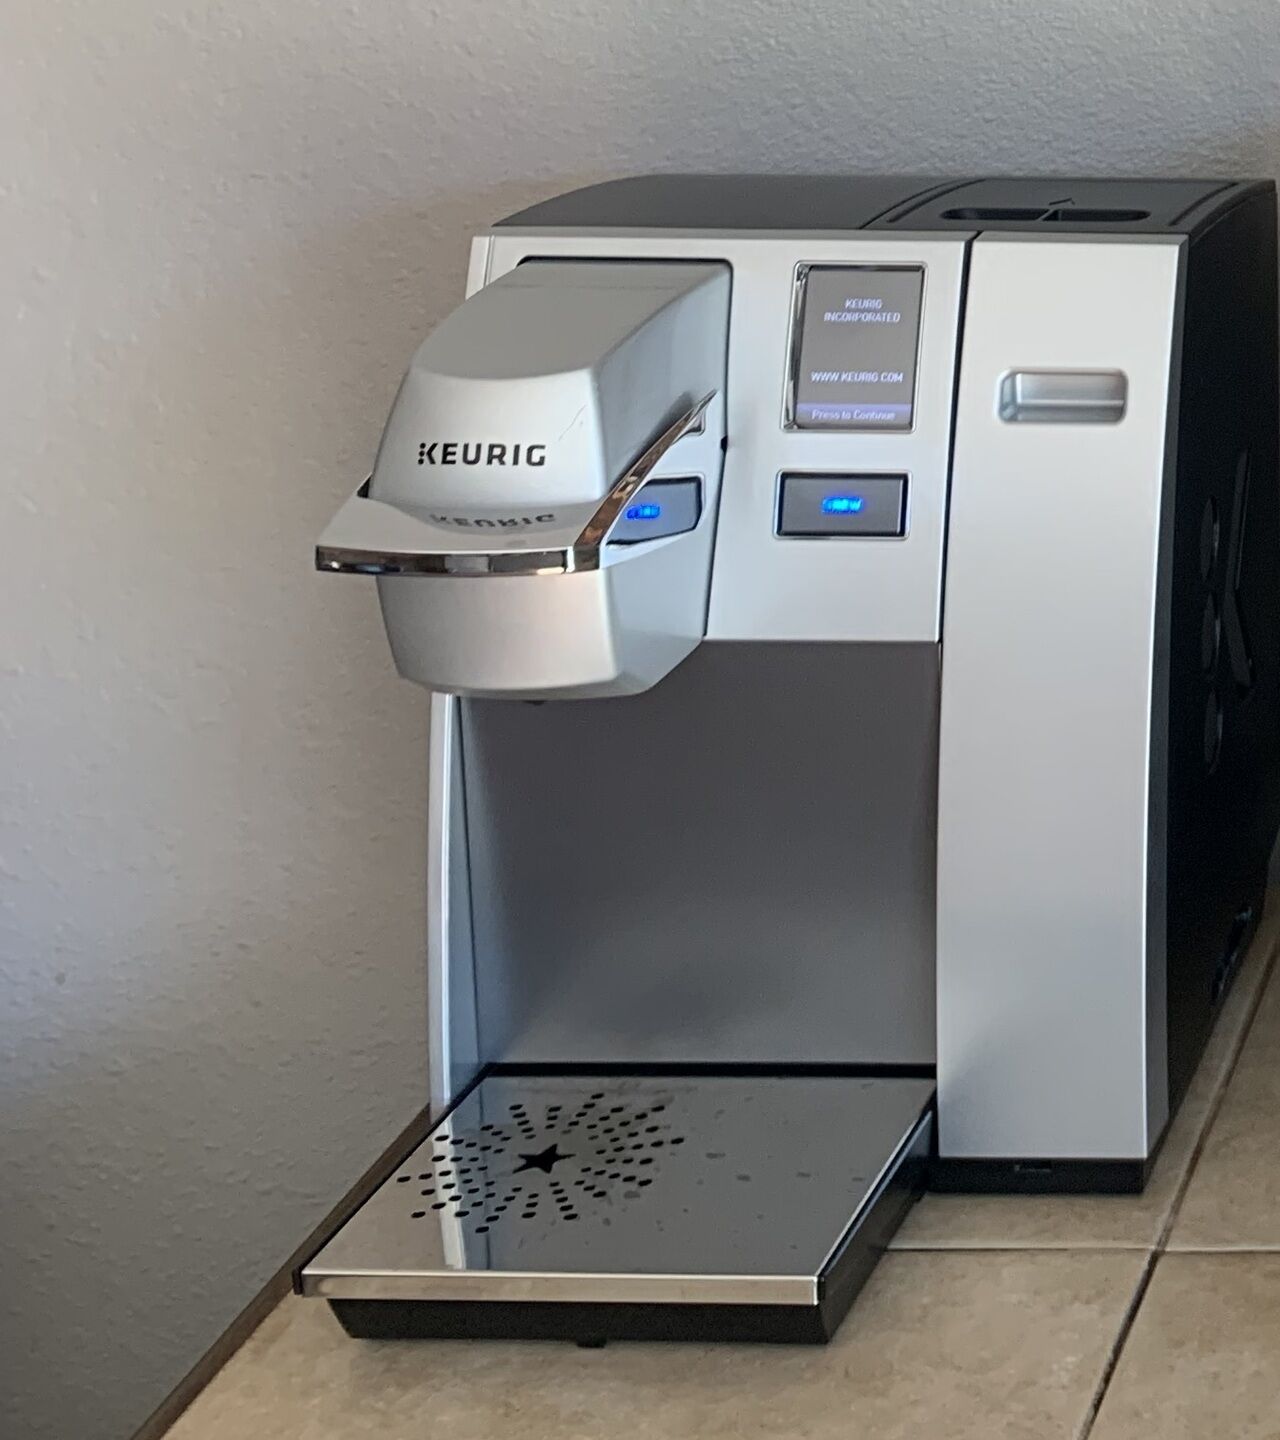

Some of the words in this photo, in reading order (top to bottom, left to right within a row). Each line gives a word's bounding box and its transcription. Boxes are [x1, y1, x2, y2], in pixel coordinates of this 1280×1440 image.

[845, 298, 883, 309] KEURIG
[824, 312, 901, 323] INCORPORATED
[811, 409, 841, 420] Press
[842, 410, 851, 419] to
[853, 409, 896, 420] Continue
[418, 442, 547, 466] KEURIG
